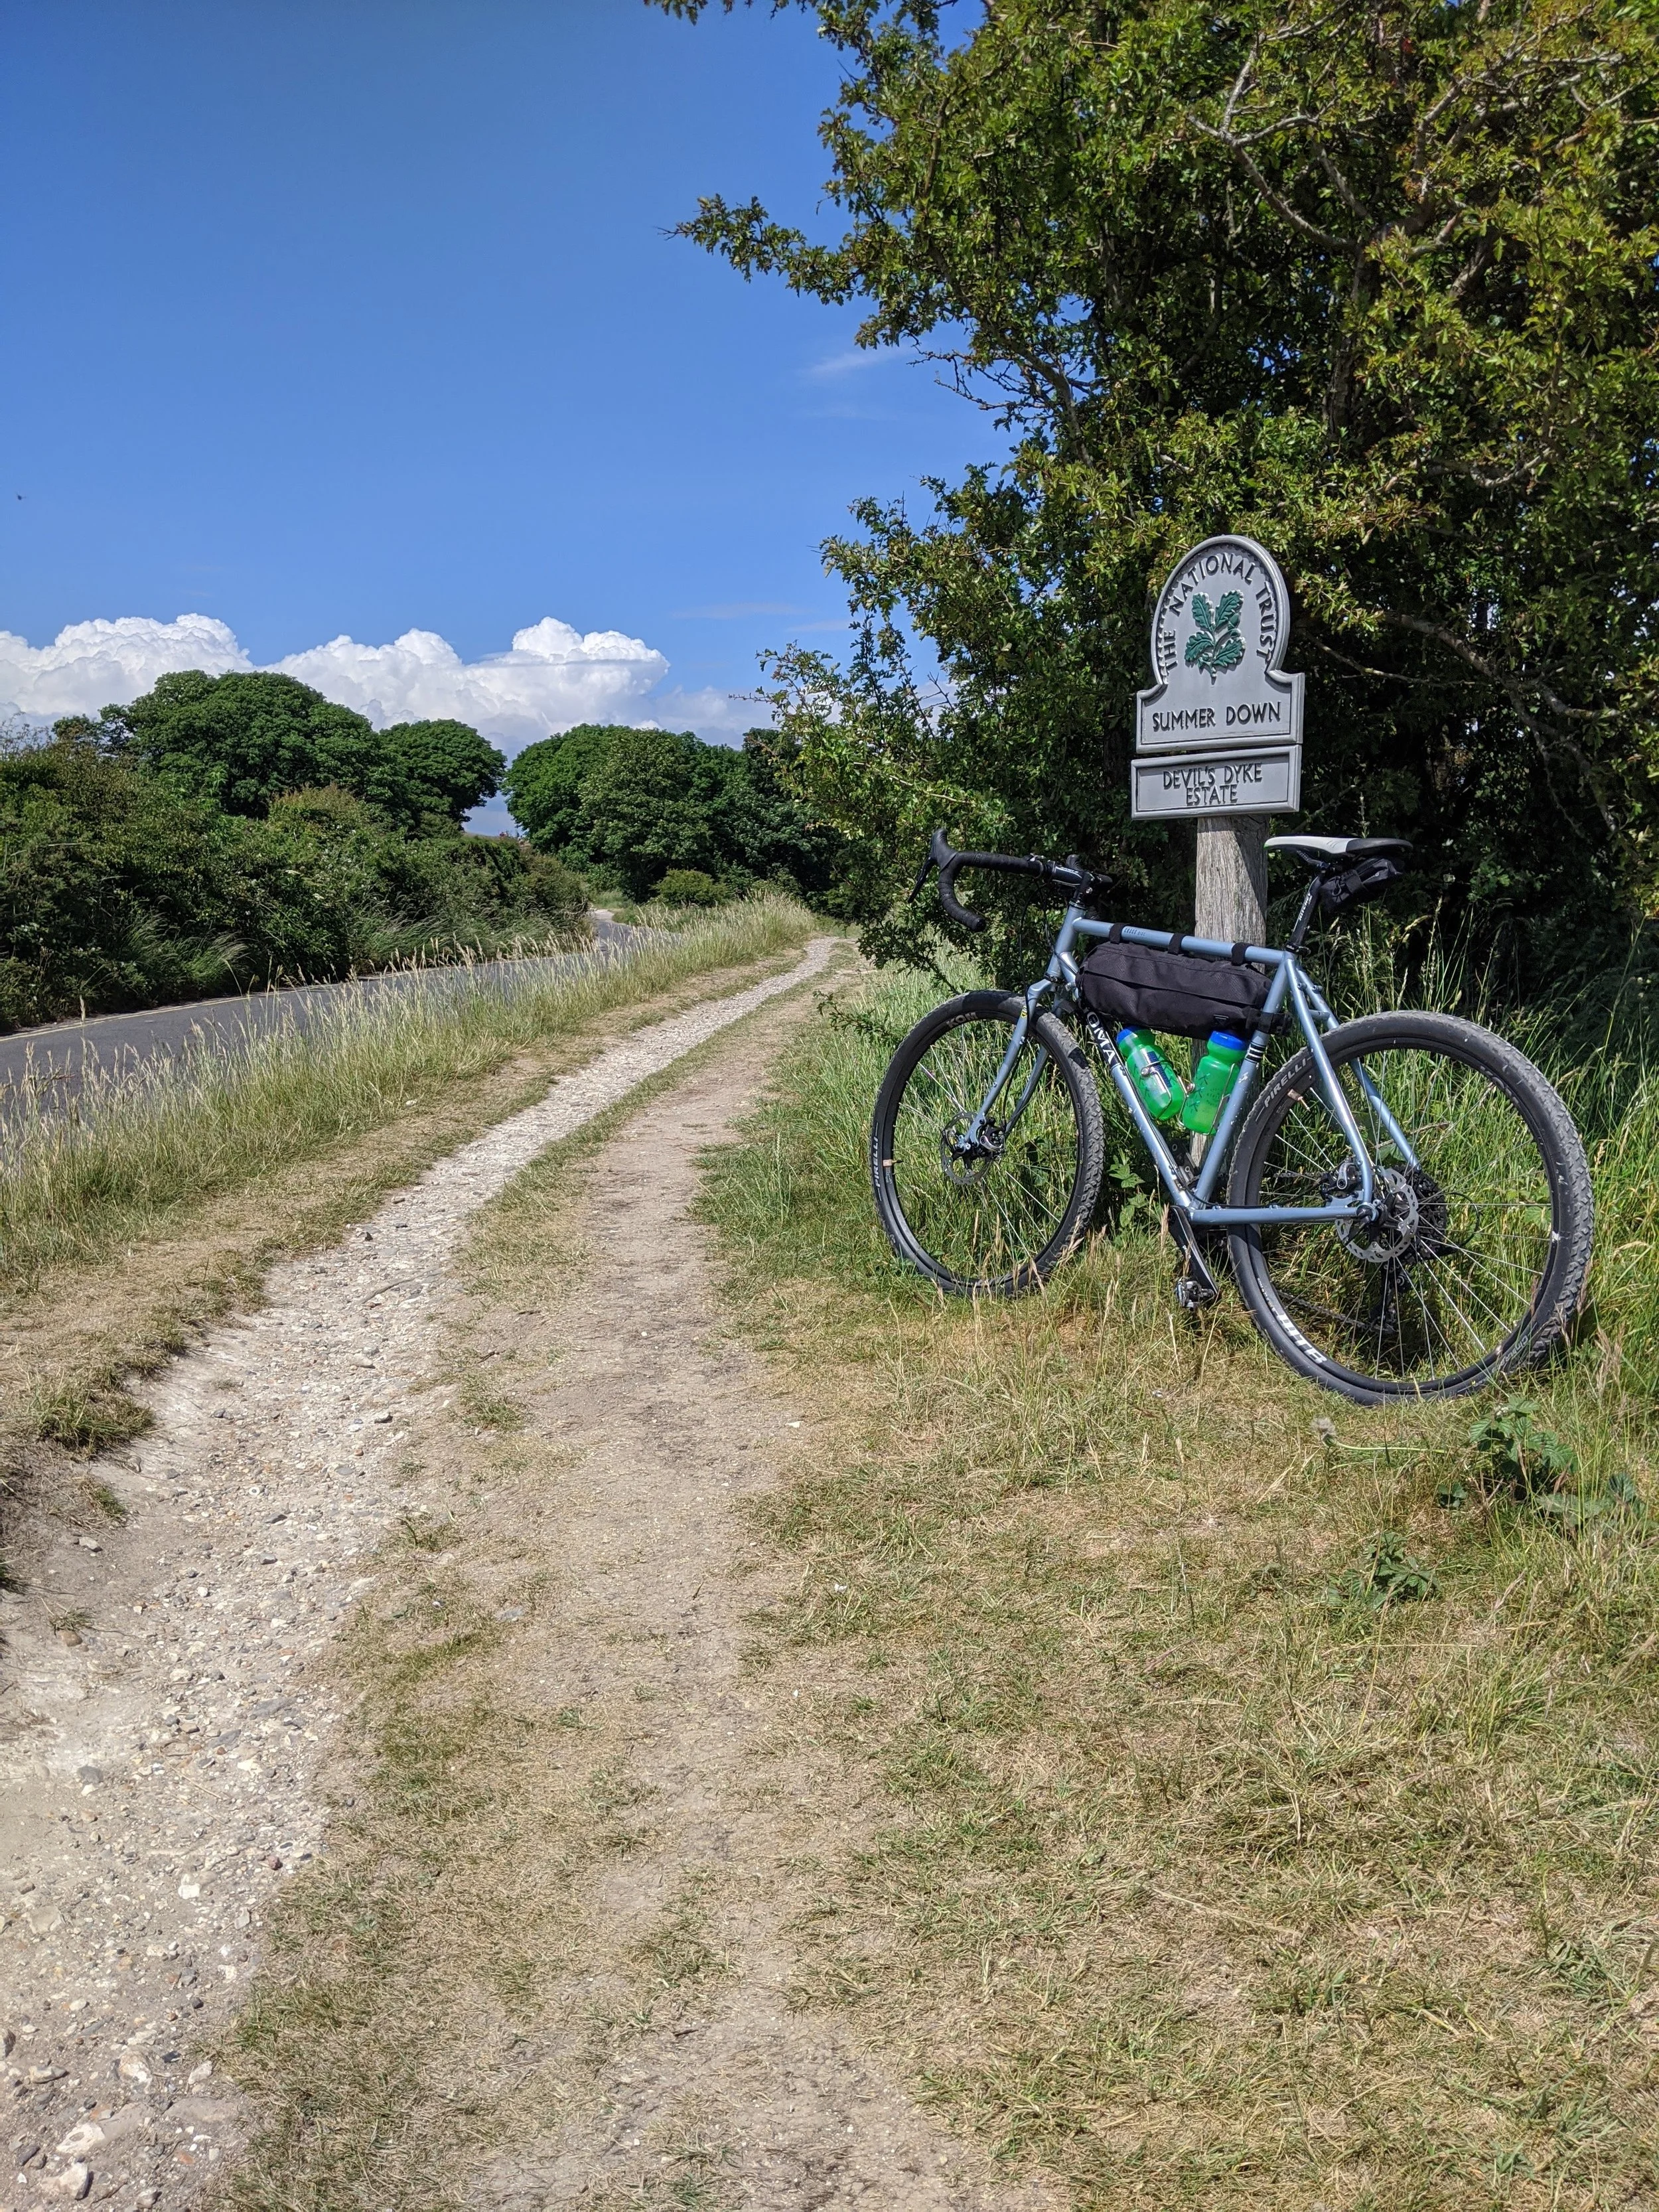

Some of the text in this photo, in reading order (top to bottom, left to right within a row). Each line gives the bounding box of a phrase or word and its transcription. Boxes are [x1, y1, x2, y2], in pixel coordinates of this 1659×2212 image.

[1163, 553, 1275, 674] THE NATIONAL TRUST
[1153, 701, 1281, 732] SUMMER DOWN
[1163, 763, 1263, 790] DEVIL'S DYKE
[1187, 784, 1238, 806] ESTATE
[1086, 1011, 1115, 1065] OMA
[1264, 1058, 1306, 1107] PIRELLI
